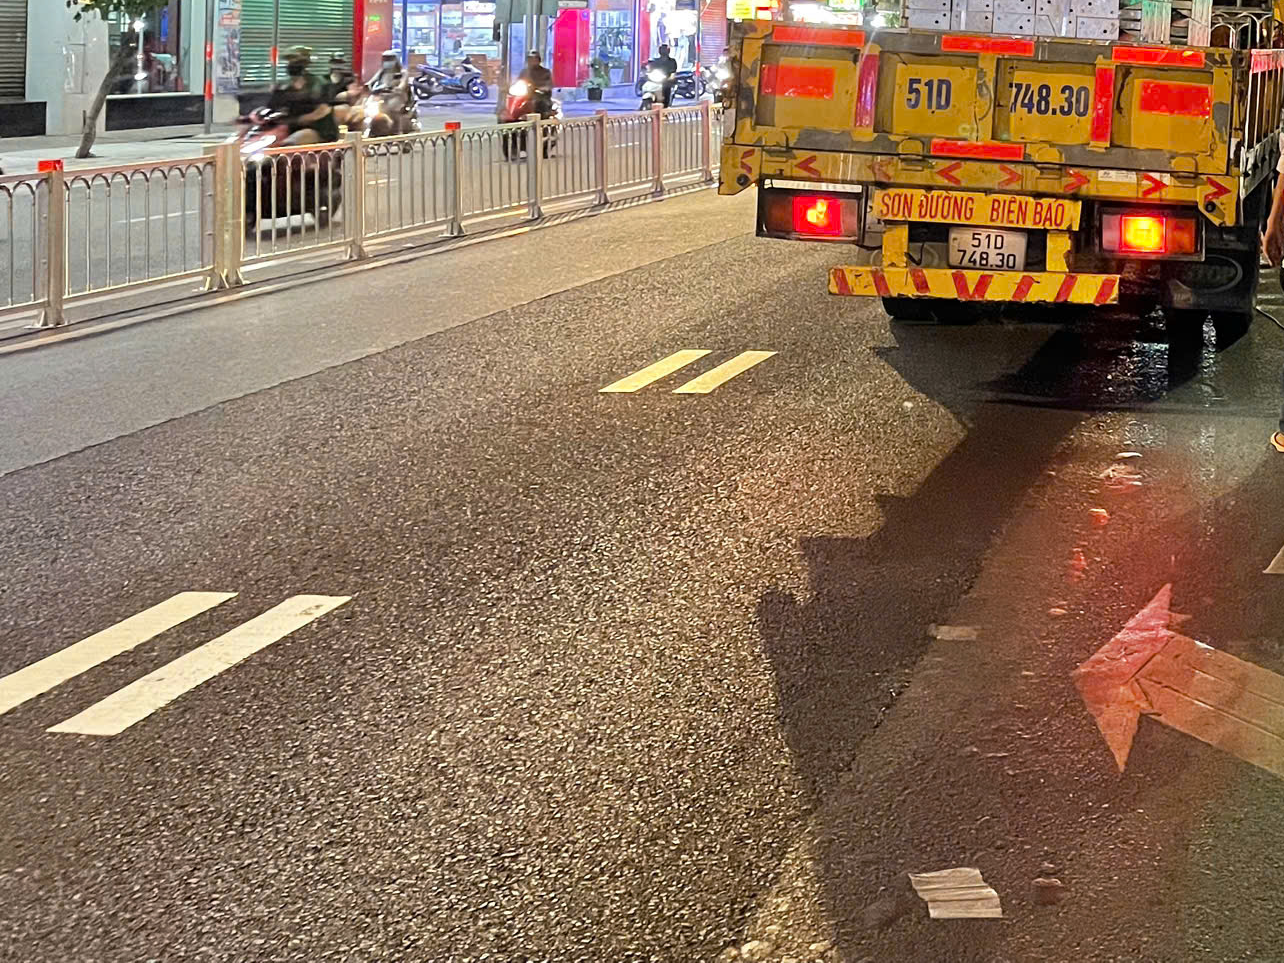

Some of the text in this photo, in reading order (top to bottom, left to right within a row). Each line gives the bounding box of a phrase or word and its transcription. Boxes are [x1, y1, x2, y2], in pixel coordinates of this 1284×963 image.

[906, 78, 952, 111] 51D
[1009, 82, 1090, 117] 748.30
[881, 191, 914, 219] SƠN
[971, 232, 1005, 250] 51D
[957, 249, 1017, 268] 748.30
